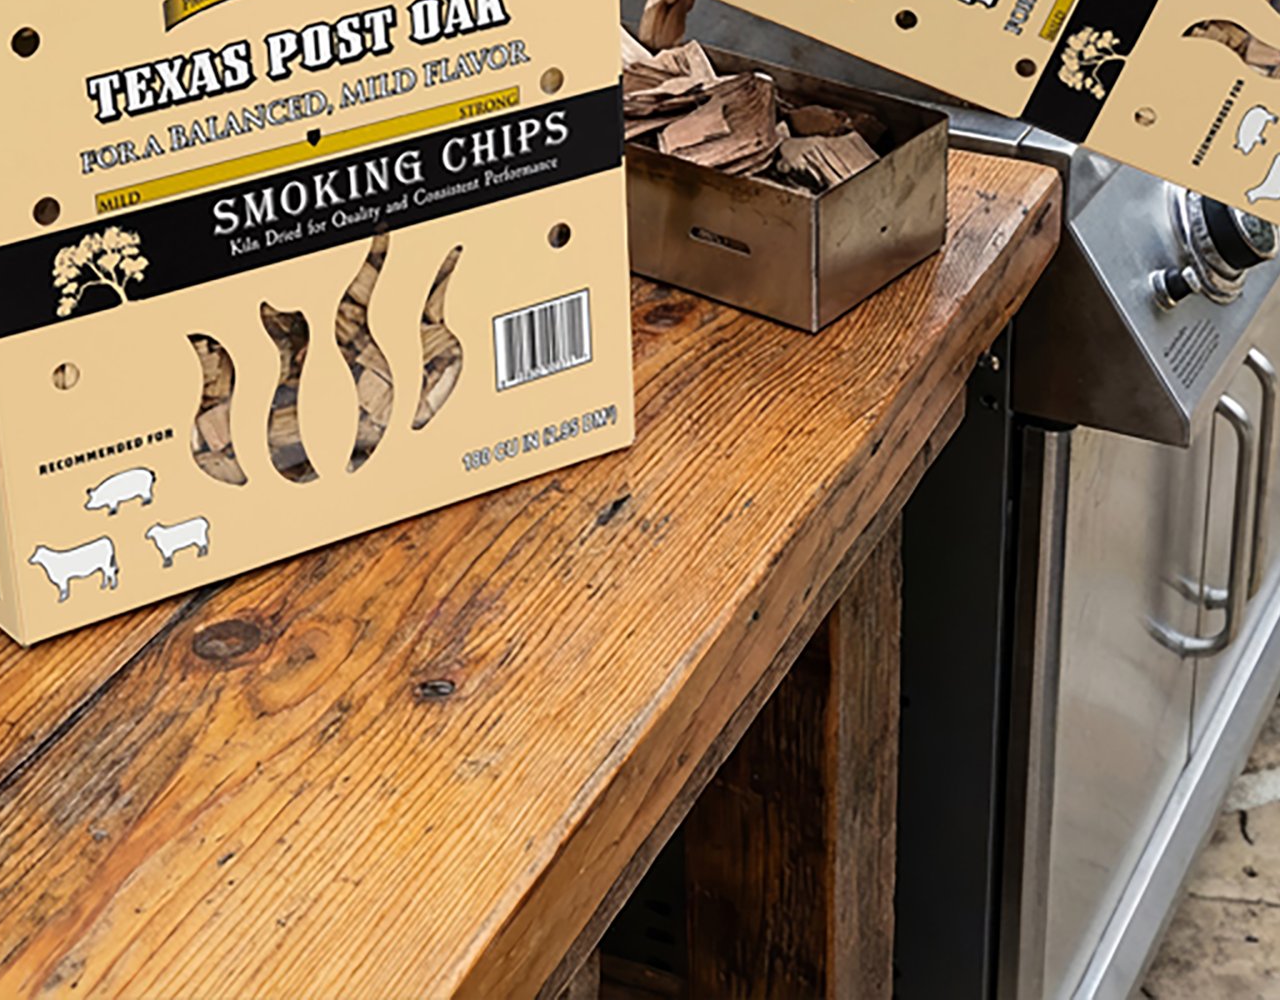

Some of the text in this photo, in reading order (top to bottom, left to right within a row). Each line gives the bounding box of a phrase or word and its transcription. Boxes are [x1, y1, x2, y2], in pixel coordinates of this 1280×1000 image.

[80, 38, 531, 175] FOR A BALANCED, MILD FLAVOR
[85, 38, 258, 125] TEXAS
[263, 4, 397, 83] POST
[97, 92, 519, 213] MILD STRONG
[211, 110, 569, 237] SMOKING CHIPS
[229, 156, 559, 257] Kiln Dried for Quality and Consistent Performance
[38, 427, 175, 476] RECOMMENDED FOR
[461, 446, 491, 472] 180
[493, 436, 519, 464] CU
[521, 429, 540, 454] IN
